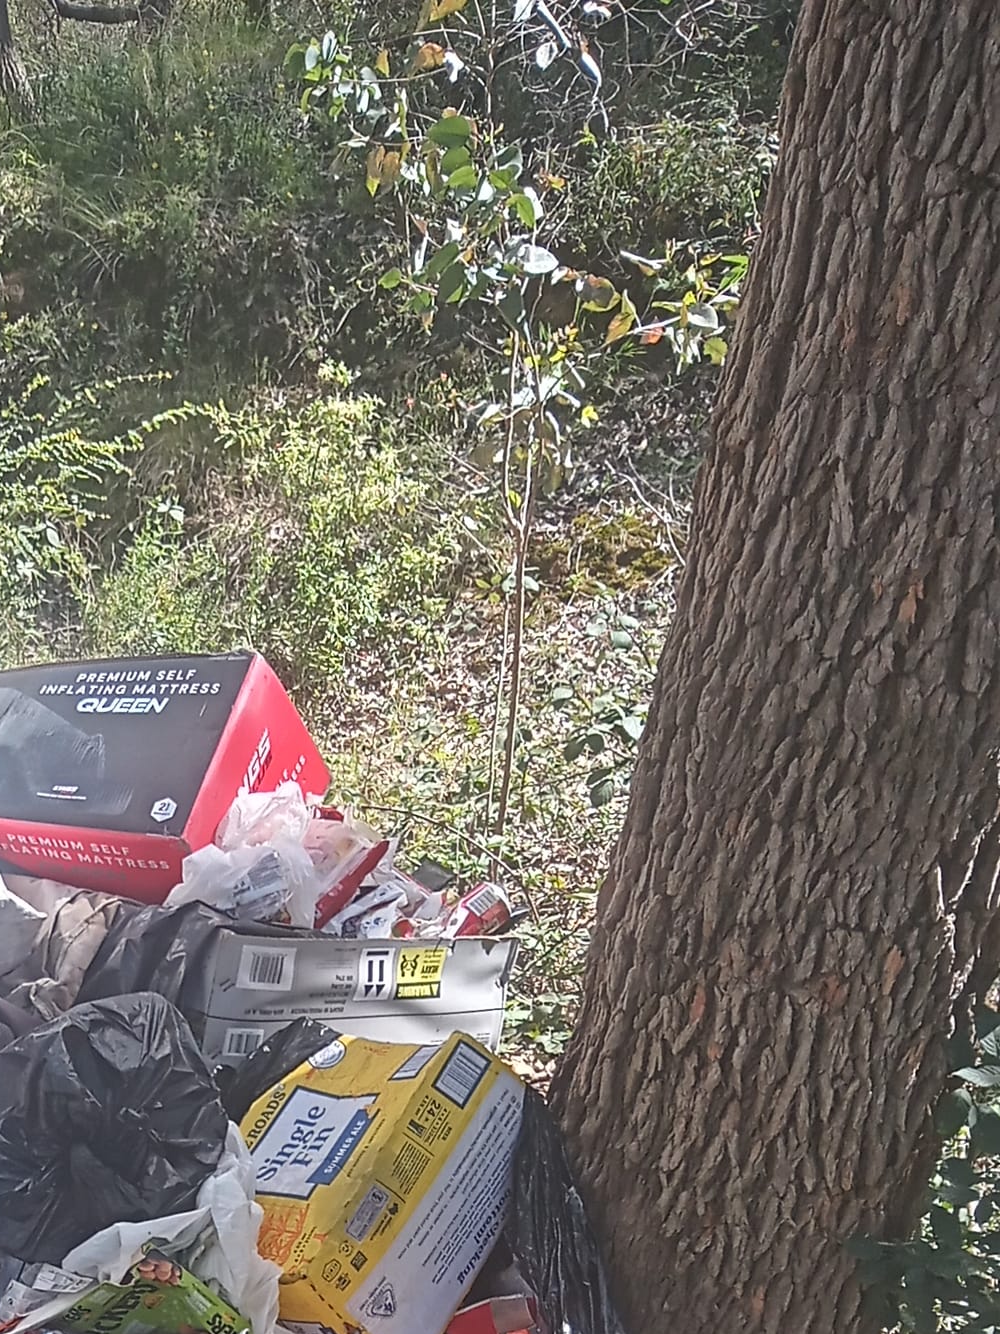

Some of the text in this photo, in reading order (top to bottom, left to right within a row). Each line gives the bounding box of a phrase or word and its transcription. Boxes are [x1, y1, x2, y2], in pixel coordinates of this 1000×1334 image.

[76, 669, 197, 683] PREMIUM SELF
[39, 683, 221, 695] INFLATING MATTRESS
[76, 698, 169, 714] QUEEN
[6, 833, 130, 856] PREMIUM SELF
[79, 852, 171, 870] MATTRESS
[248, 1090, 286, 1140] ROADS
[256, 1106, 326, 1181] Single
[290, 1126, 336, 1167] Fin
[324, 1138, 354, 1174] SUMMER
[352, 1120, 367, 1137] ALE
